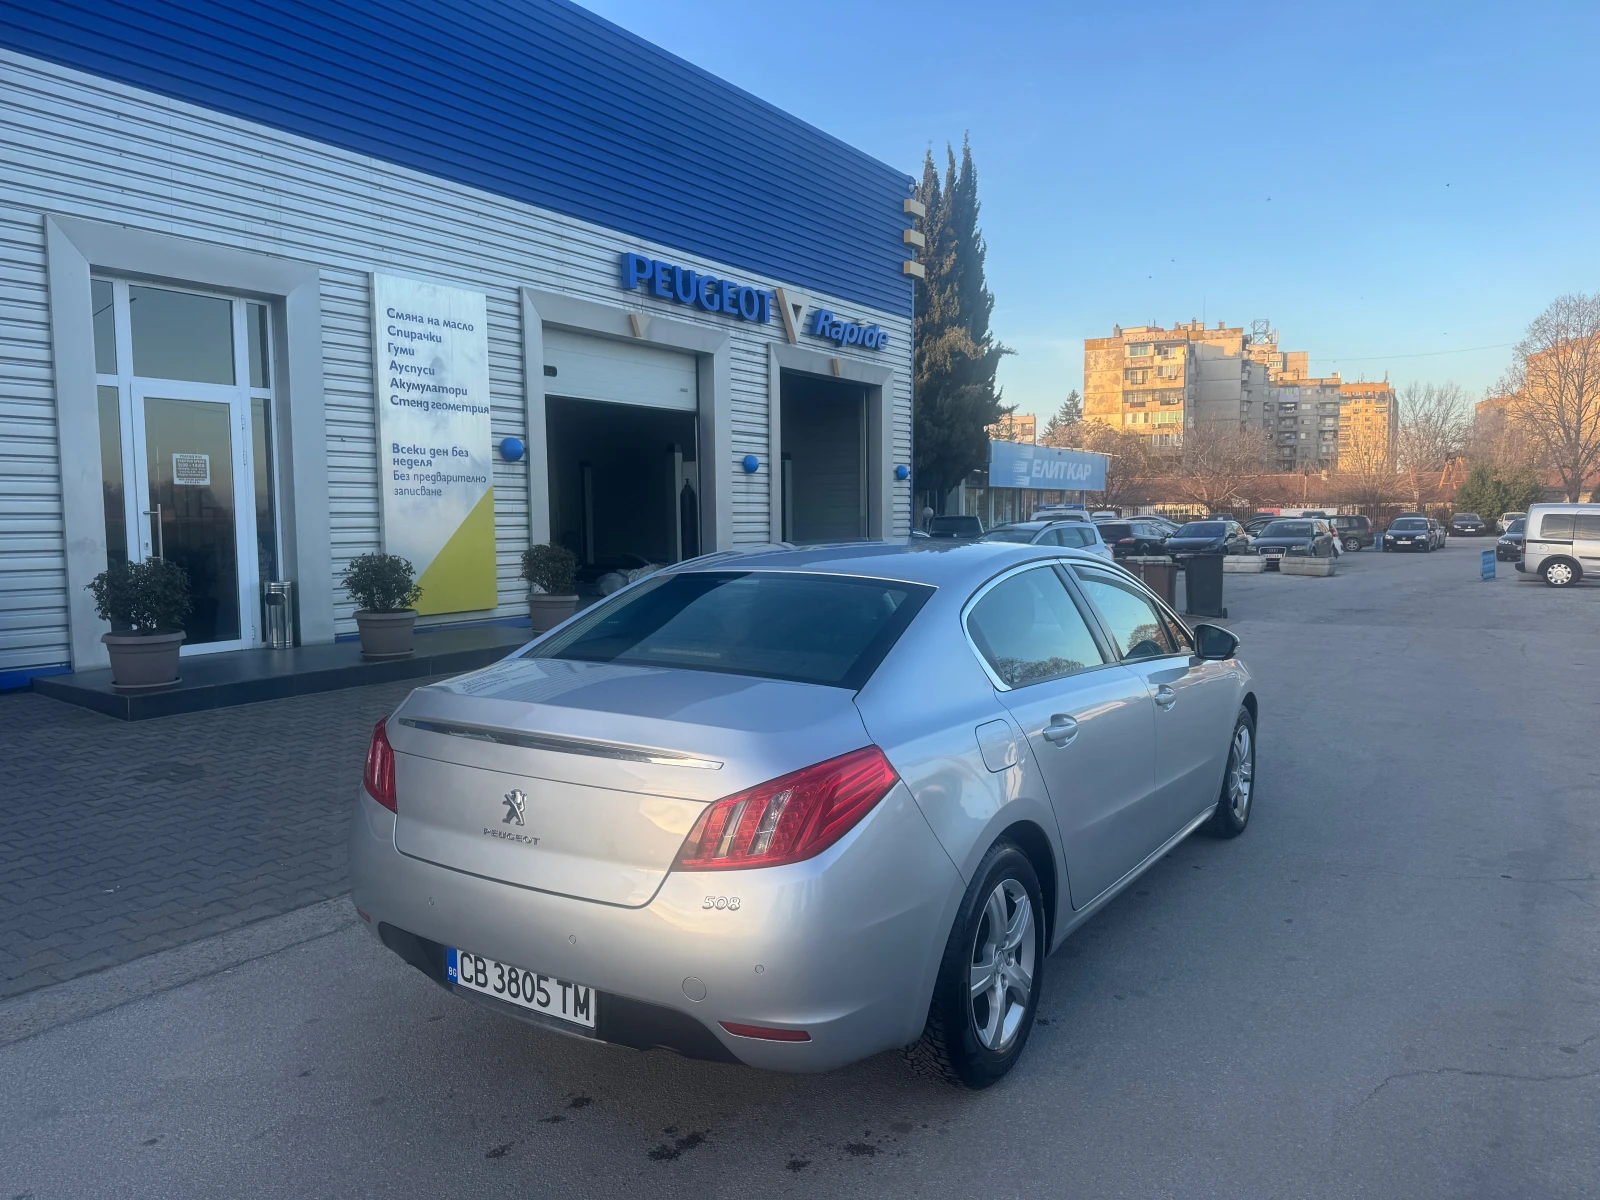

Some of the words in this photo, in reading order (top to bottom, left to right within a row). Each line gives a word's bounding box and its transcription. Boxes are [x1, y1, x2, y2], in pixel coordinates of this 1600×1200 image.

[620, 252, 775, 324] PEUGEOT
[386, 307, 424, 324] Смяна
[427, 317, 440, 326] на
[442, 320, 474, 332] масло
[387, 325, 442, 343] Спирачки
[811, 308, 889, 350] Rapide
[387, 342, 415, 357] Гуми
[389, 360, 435, 376] Ауспуси
[390, 378, 468, 396] Акумулатори
[390, 395, 429, 412] Стенд
[431, 402, 490, 416] геометрия
[392, 442, 426, 456] Всеки
[429, 447, 449, 458] ден
[451, 446, 469, 458] без
[392, 457, 433, 470] неделя
[1032, 459, 1092, 480] ЕЛИТКАР
[393, 470, 411, 482] Без
[413, 472, 487, 486] предварително
[394, 487, 443, 498] записване
[483, 827, 541, 846] PEUGEOT
[702, 896, 741, 911] 508
[448, 966, 457, 977] BG
[460, 952, 488, 988] CB
[493, 962, 551, 1008] 3805
[556, 980, 590, 1022] TM
